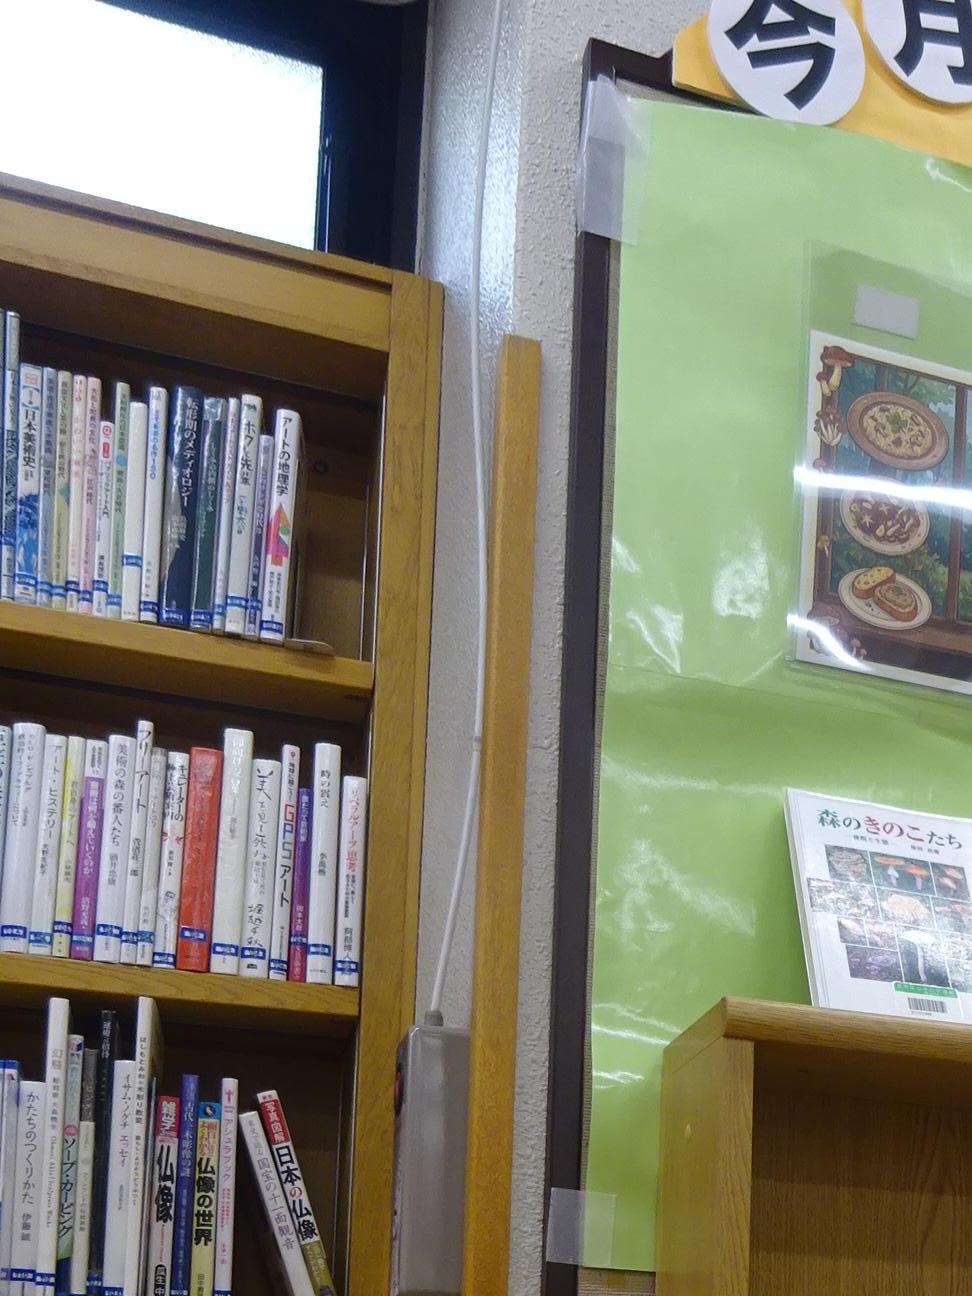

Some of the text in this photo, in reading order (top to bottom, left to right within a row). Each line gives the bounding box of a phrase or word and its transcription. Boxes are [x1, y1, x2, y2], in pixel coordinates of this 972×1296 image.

[816, 808, 963, 851] 森のきのこたち
[20, 1090, 41, 1206] かたちのつくりかた
[56, 1138, 78, 1238] ソープ・カービング
[155, 1144, 175, 1224] 仏像
[275, 1145, 319, 1241] 日本の仏像
[193, 1157, 216, 1247] 仏像の世界
